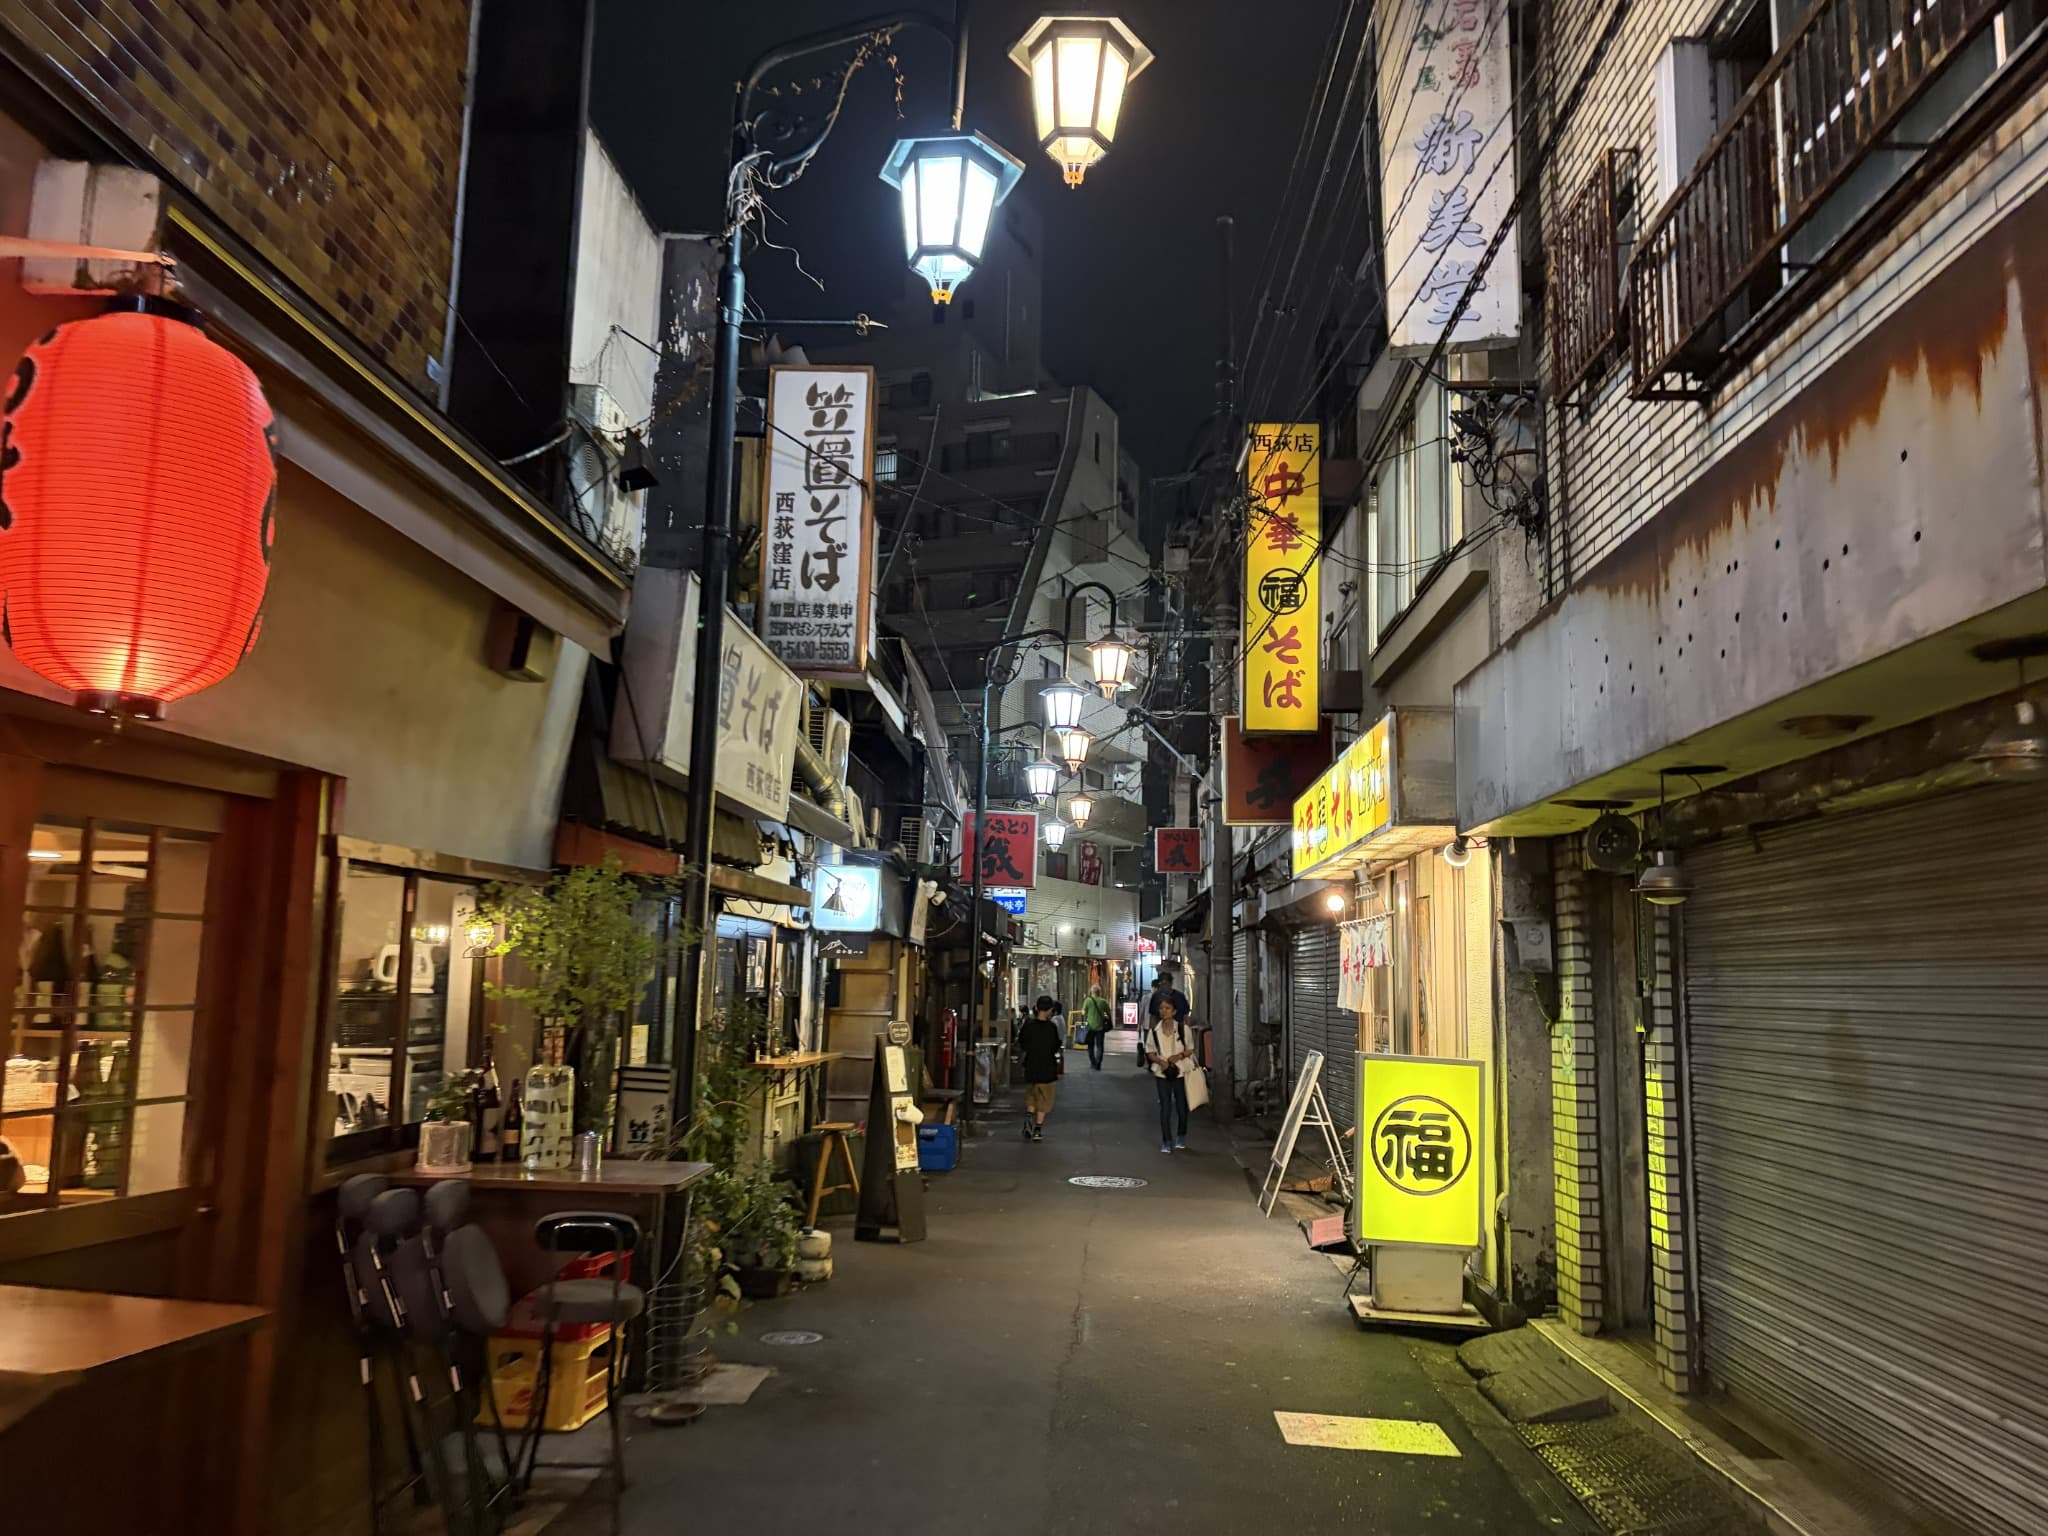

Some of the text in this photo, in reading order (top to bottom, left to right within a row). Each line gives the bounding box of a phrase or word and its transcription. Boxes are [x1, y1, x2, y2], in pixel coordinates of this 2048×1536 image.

[1413, 110, 1487, 325] 新美堂
[1254, 433, 1313, 452] 西荻店
[801, 381, 855, 591] 笠置そば
[770, 492, 795, 591] 西荻窪店
[768, 601, 853, 619] 加盟店募集中
[1381, 1110, 1455, 1182] 福
